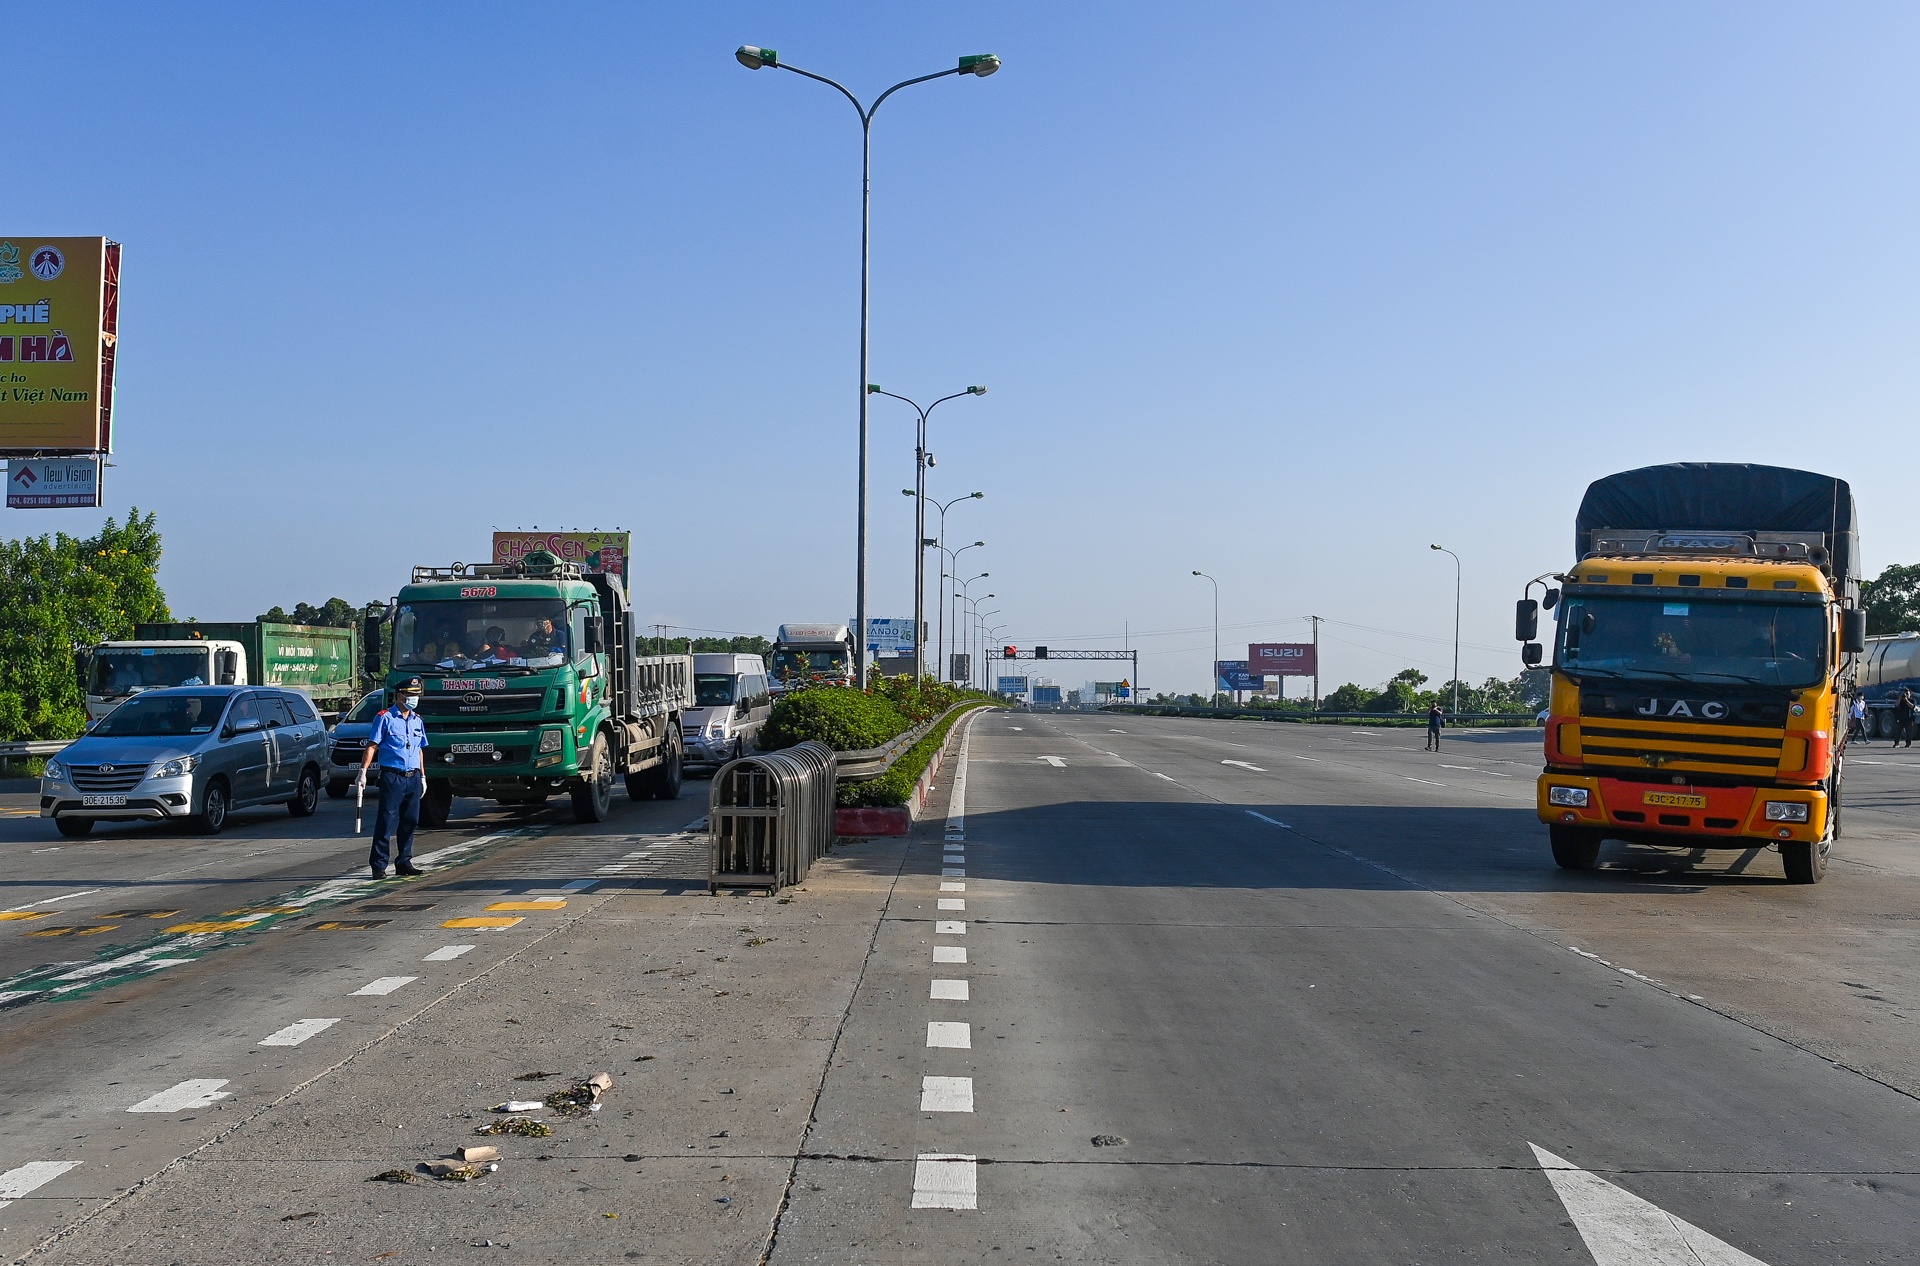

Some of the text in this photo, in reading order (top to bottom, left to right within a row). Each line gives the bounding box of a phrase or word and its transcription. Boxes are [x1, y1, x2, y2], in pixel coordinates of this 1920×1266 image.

[20, 329, 75, 362] HÀ
[10, 372, 27, 383] ho
[13, 388, 45, 404] Việt
[48, 388, 88, 402] Nam
[43, 465, 92, 482] New Vision
[460, 586, 497, 598] 5678
[1260, 649, 1303, 657] ISUZU
[442, 679, 476, 691] THANH
[465, 694, 481, 703] TMT
[1638, 698, 1724, 719] JAC
[84, 796, 126, 805] 30E-215.36
[1648, 793, 1701, 806] 43C-217.75
